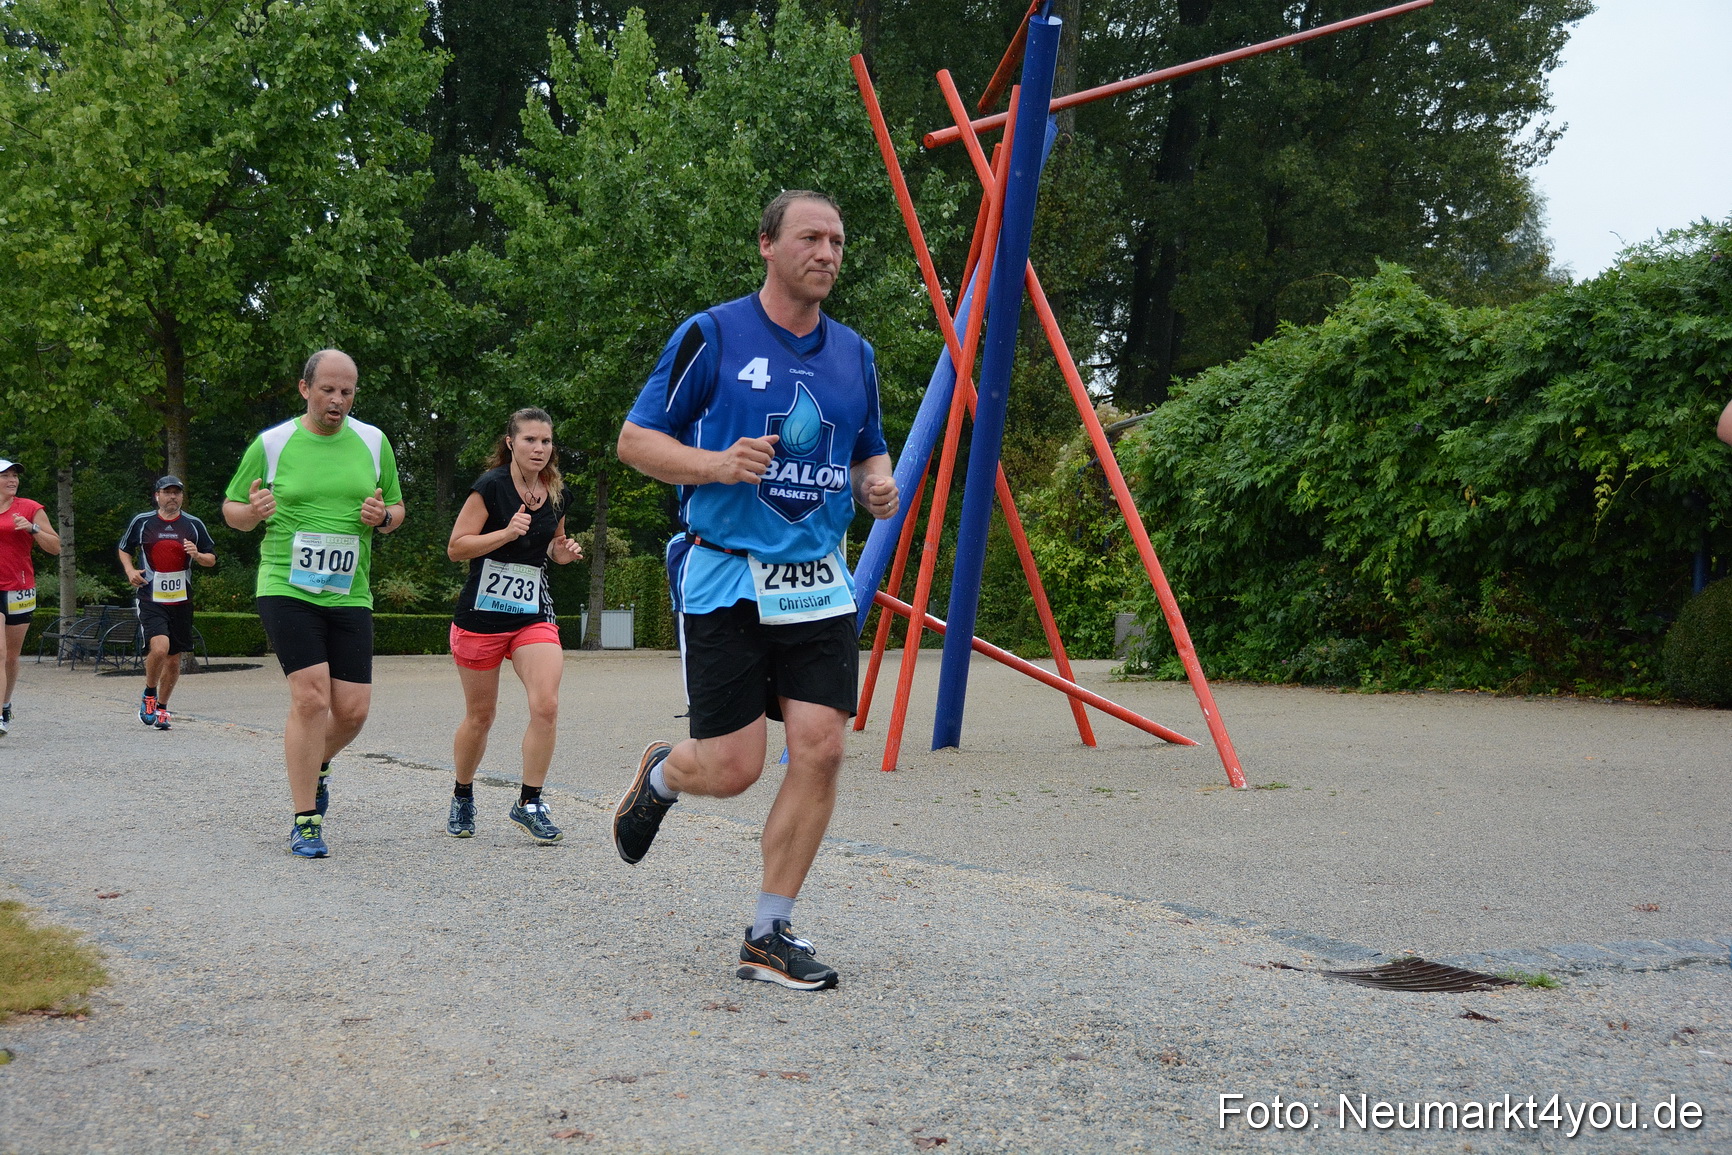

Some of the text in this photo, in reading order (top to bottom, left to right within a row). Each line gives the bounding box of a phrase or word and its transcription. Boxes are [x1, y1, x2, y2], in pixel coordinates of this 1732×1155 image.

[738, 357, 771, 389] 4
[762, 459, 845, 489] BALON
[769, 488, 819, 501] BASKETS
[299, 546, 354, 572] 3100
[161, 578, 181, 591] 609
[761, 555, 834, 590] 2495
[485, 572, 535, 602] 2733
[491, 599, 525, 614] Melanie
[779, 594, 831, 611] Christian
